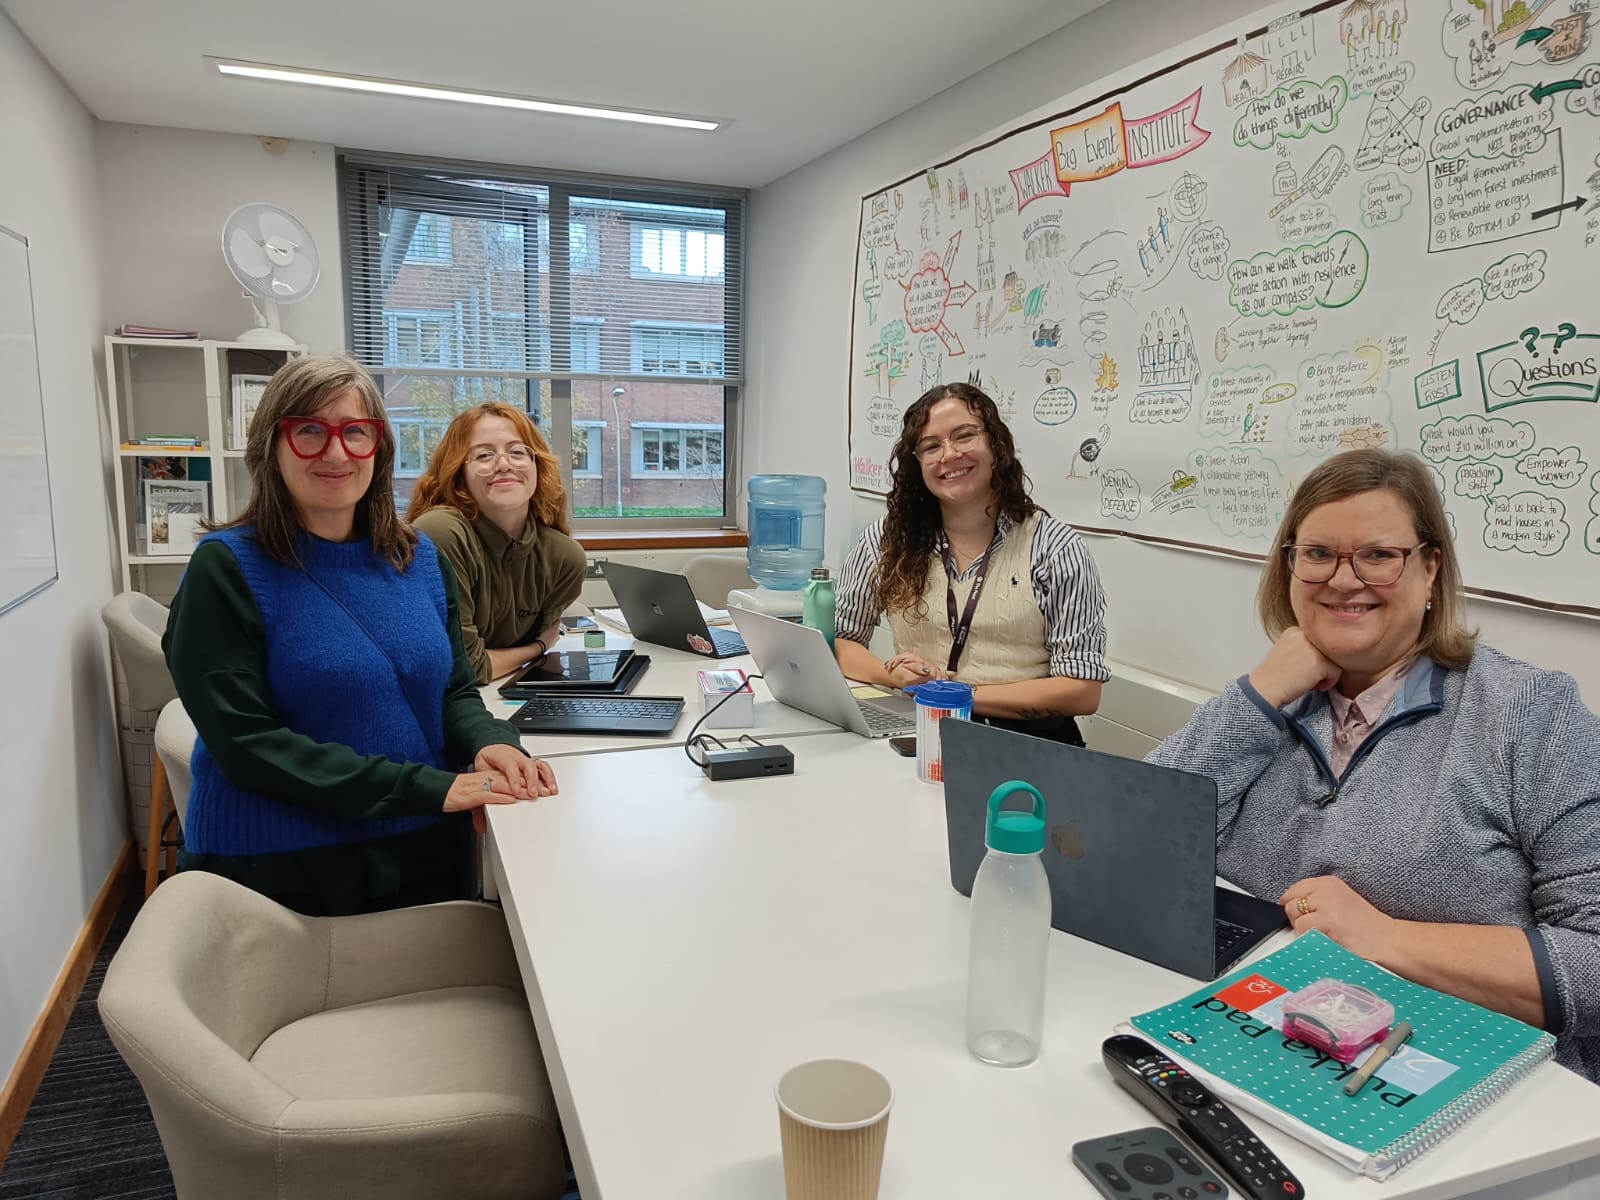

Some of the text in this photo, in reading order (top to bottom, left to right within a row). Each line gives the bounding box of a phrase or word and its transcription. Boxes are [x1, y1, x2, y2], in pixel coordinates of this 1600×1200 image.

[1232, 86, 1259, 105] HEALTH
[1252, 87, 1305, 117] How do we
[1441, 89, 1528, 133] GOVERNANCE
[1127, 105, 1192, 162] INSTITUTE
[1238, 121, 1249, 141] do
[1251, 116, 1278, 147] things
[1436, 110, 1549, 155] Global implementation is
[1055, 140, 1077, 172] Big
[1083, 126, 1120, 164] Event
[1487, 137, 1506, 153] NOT
[1510, 142, 1533, 157] fruit
[1435, 159, 1470, 177] NEED:
[1447, 157, 1525, 192] Legal frameworks
[1016, 158, 1053, 200] WALKER
[1484, 178, 1507, 199] forest
[1511, 164, 1560, 189] investment
[1448, 192, 1531, 222] Renewable energy
[1450, 211, 1521, 243] BE BOTTOM UP
[1232, 246, 1336, 282] How can we walk towards
[1233, 278, 1260, 299] climate
[1262, 271, 1288, 292] action
[1292, 266, 1311, 288] with
[1253, 292, 1267, 309] our
[1420, 365, 1456, 388] LISTEN
[1488, 357, 1597, 398] Questions
[1424, 382, 1452, 402] FIRST
[1448, 425, 1474, 438] would
[1478, 424, 1494, 443] you
[1427, 444, 1452, 460] spend
[1474, 439, 1505, 455] million
[1507, 439, 1518, 452] on
[855, 456, 883, 477] Walker
[1460, 466, 1496, 485] paradigm
[1527, 457, 1570, 473] Empower
[1102, 473, 1133, 489] DENIAL
[1540, 470, 1574, 484] women
[1116, 487, 1124, 498] IS
[1468, 482, 1489, 494] shift
[1103, 497, 1138, 513] DEFENSE
[1515, 505, 1524, 515] us
[1527, 503, 1546, 515] back
[1547, 504, 1557, 516] to
[1495, 515, 1512, 528] mud
[1515, 516, 1542, 528] houses
[1501, 527, 1530, 543] modern
[1191, 996, 1418, 1110] Pukka Pad
